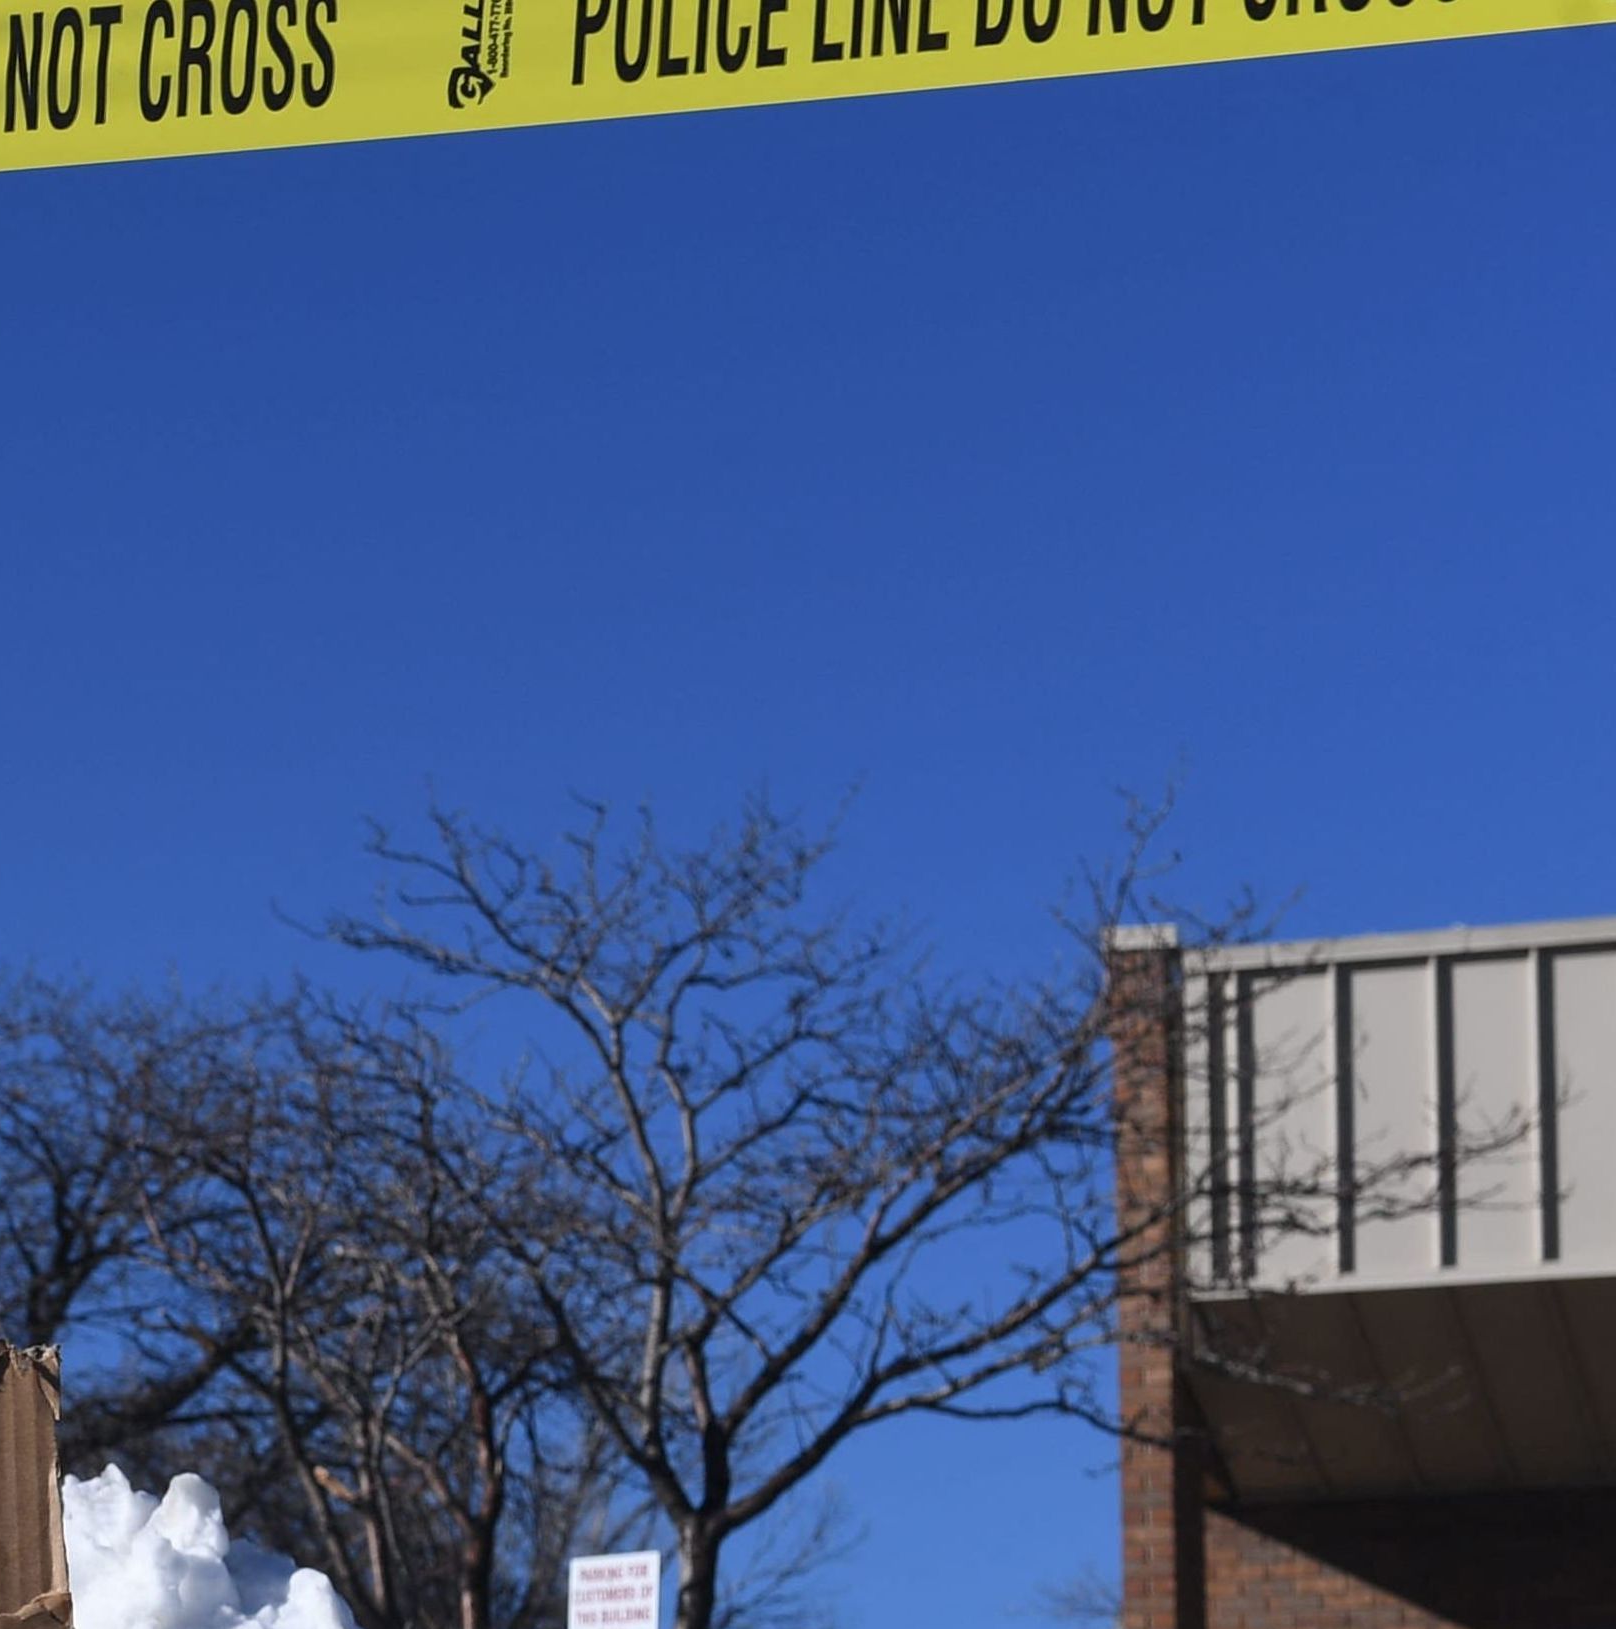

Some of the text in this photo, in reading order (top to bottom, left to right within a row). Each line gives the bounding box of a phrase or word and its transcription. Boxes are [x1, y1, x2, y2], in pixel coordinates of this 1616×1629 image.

[4, 5, 123, 132] NOT
[139, 0, 337, 122] CROSS
[448, 0, 496, 109] GALL
